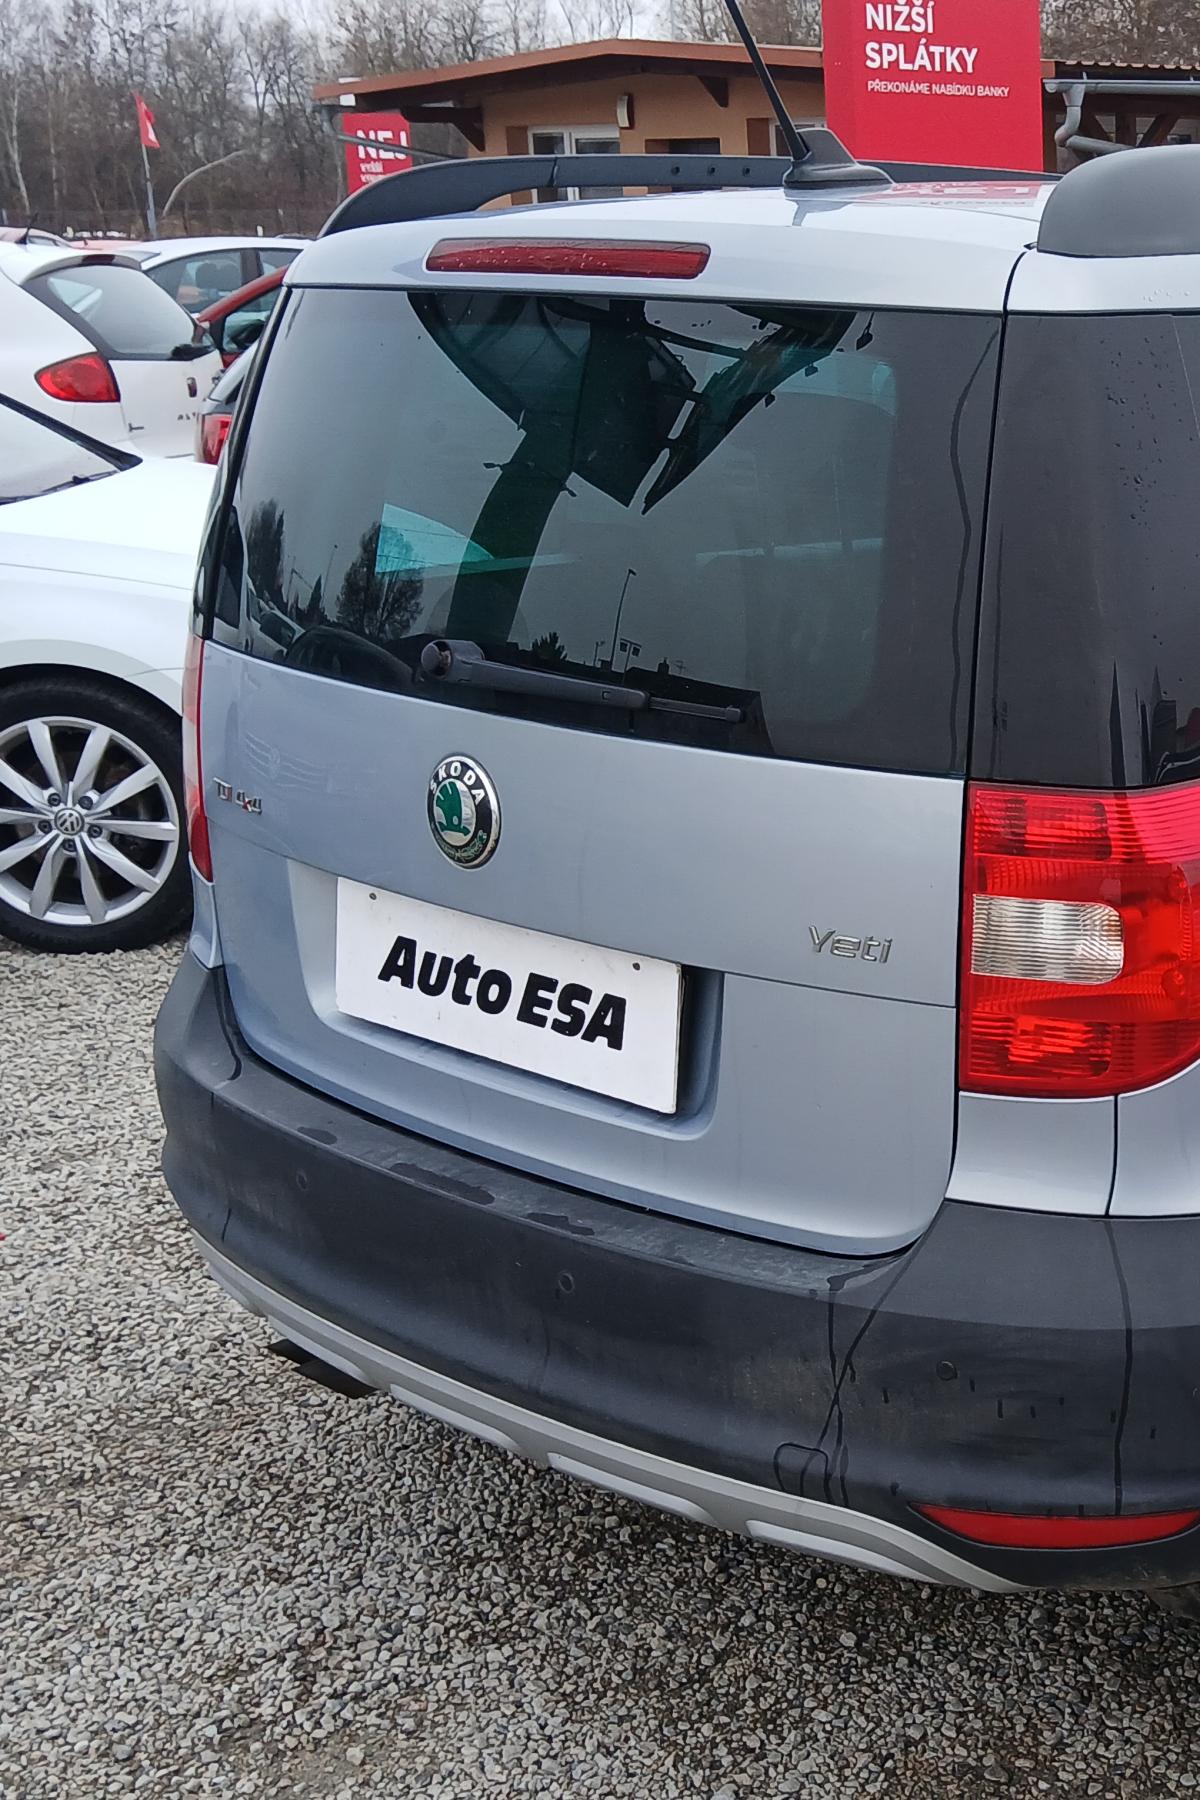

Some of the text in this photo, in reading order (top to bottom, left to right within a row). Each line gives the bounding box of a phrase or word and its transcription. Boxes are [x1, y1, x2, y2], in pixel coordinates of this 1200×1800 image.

[865, 0, 935, 33] NIŽŠÍ
[865, 38, 978, 73] SPLÁTKY
[867, 78, 1009, 98] PŘEKONÁME NABÍDKU BANKY
[808, 924, 893, 964] Yeti
[377, 935, 627, 1051] Auto ESA
